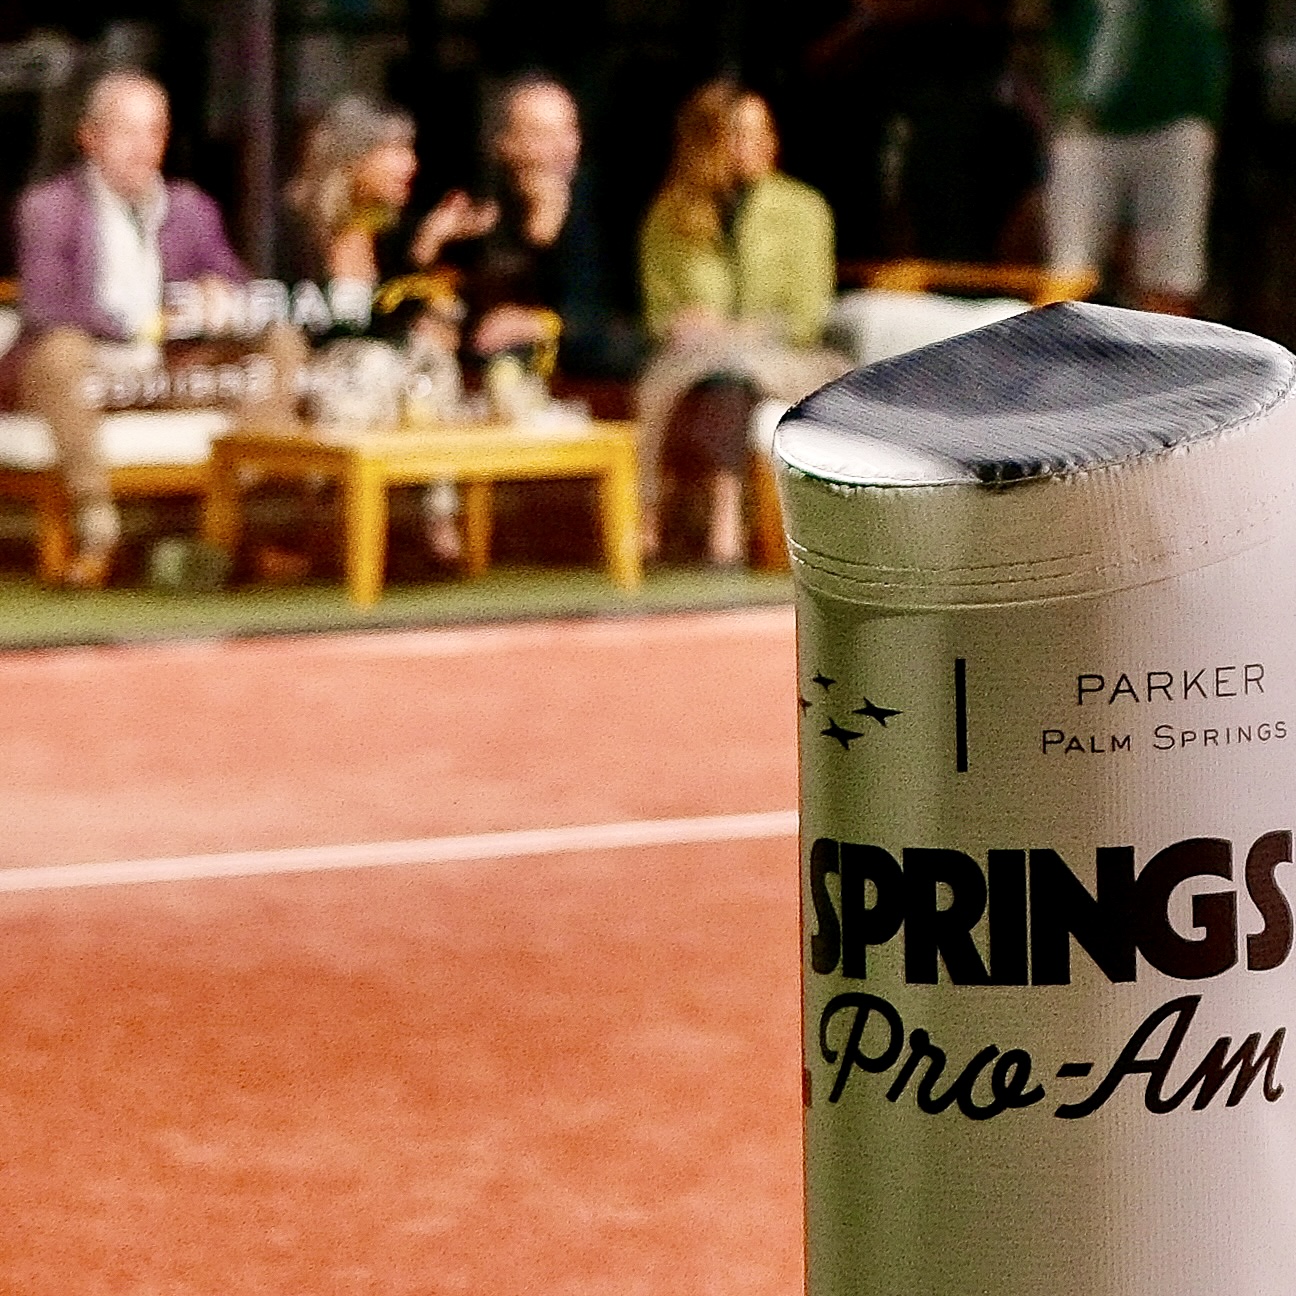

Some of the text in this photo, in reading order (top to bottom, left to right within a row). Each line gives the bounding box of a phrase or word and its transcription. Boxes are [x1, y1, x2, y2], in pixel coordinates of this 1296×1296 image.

[1076, 663, 1266, 705] PARKER
[809, 829, 1294, 987] SPRINGS
[819, 991, 1287, 1121] Pro-Am
